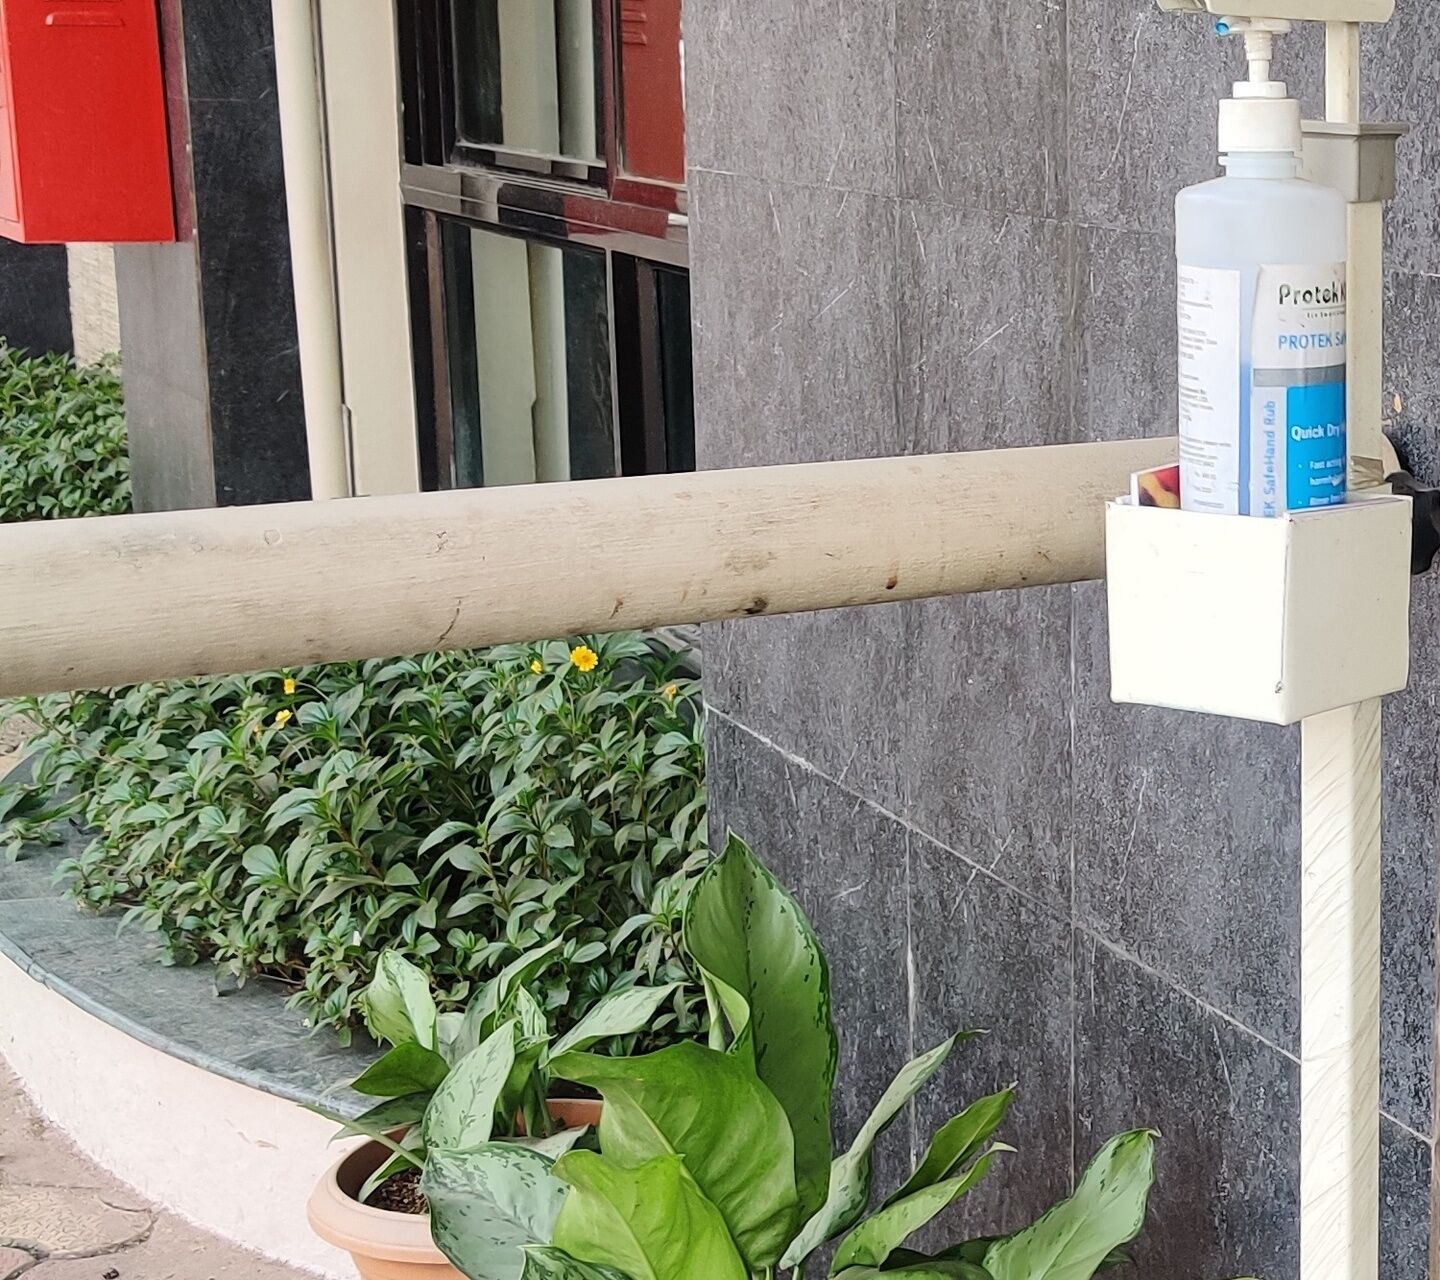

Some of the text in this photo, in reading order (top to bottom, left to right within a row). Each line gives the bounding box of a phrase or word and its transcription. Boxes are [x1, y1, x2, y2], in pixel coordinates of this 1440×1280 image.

[1279, 331, 1333, 351] PROTEK
[1263, 400, 1276, 425] Rub
[1291, 424, 1325, 442] Quick
[1263, 430, 1276, 495] SafeHand
